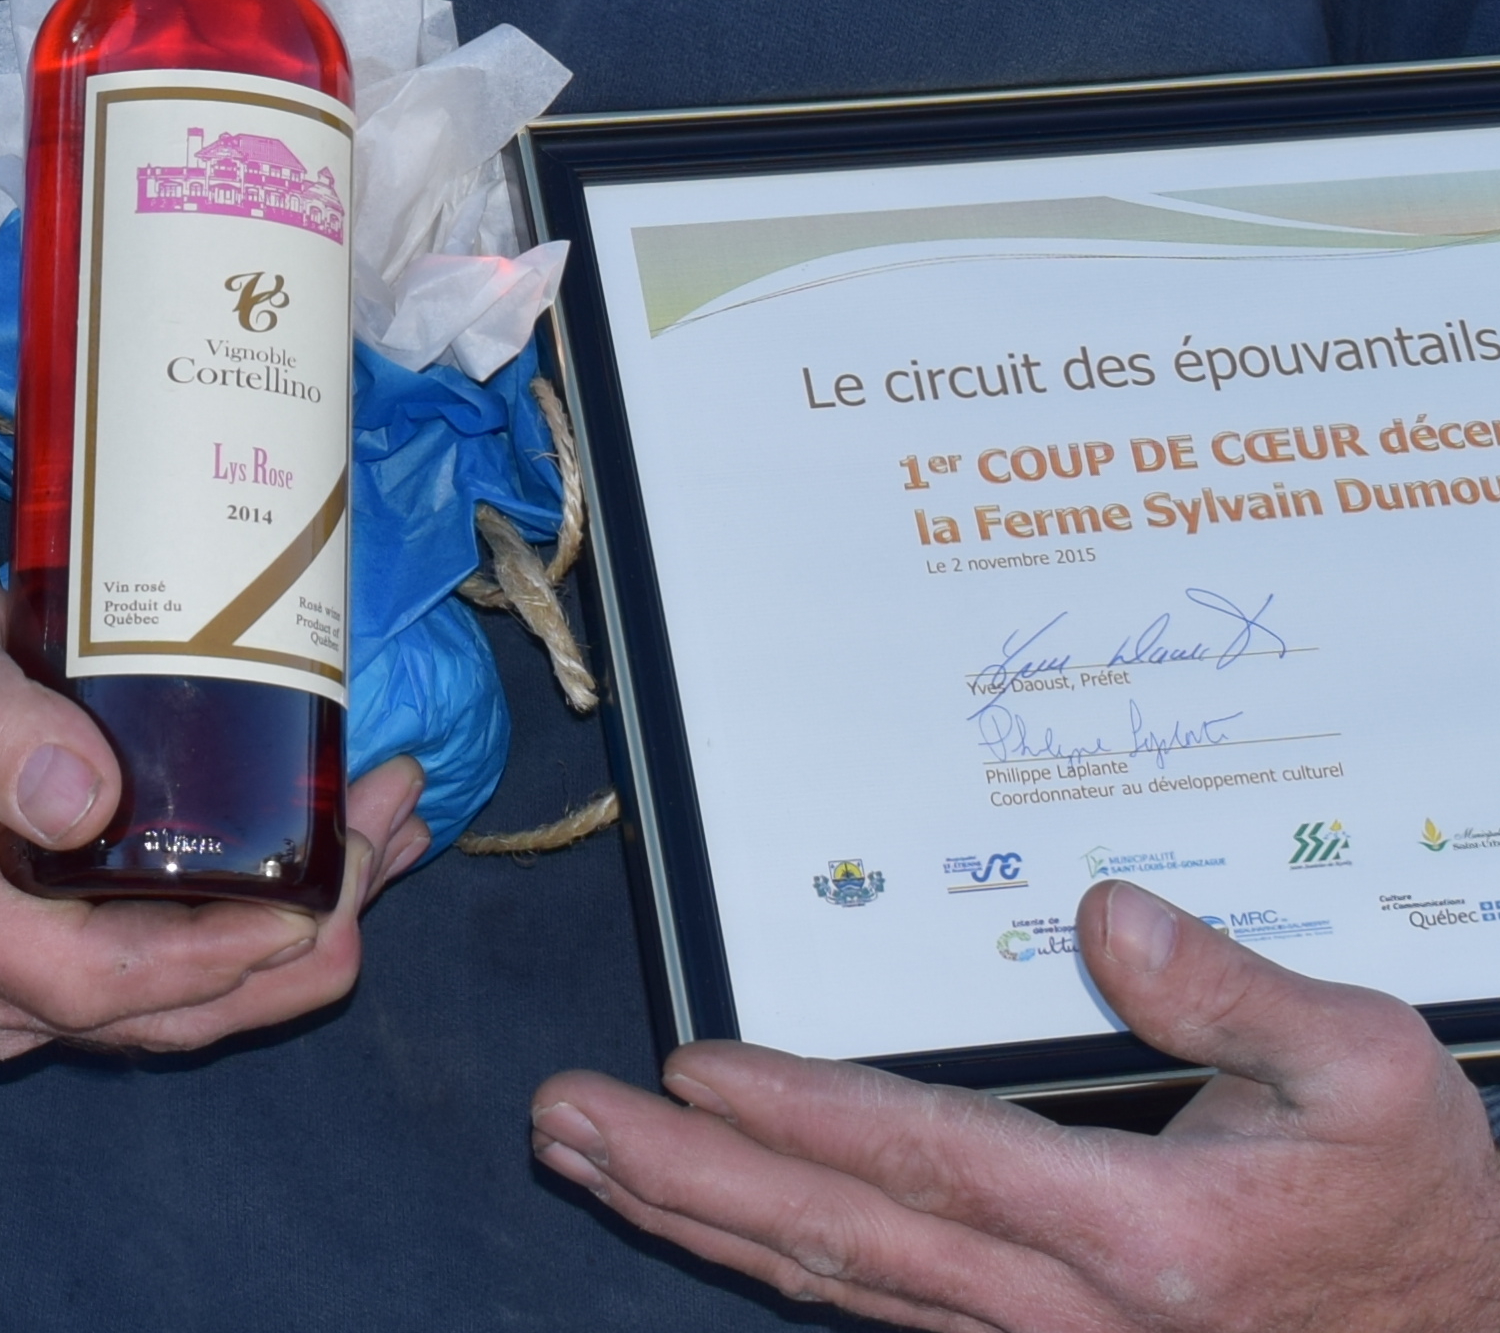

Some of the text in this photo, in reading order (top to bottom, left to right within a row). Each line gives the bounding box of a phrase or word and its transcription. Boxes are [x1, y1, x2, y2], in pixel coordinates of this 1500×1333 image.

[205, 338, 297, 368] Vignoble
[166, 356, 322, 404] Cortellino
[802, 366, 867, 410] Le
[884, 353, 1048, 404] circuit
[1062, 345, 1156, 391] des
[213, 442, 294, 490] Lys Rose
[899, 453, 963, 491] 1er
[977, 440, 1116, 484] COUP
[1130, 434, 1199, 473] DE
[1210, 421, 1370, 467] CŒUR
[226, 504, 273, 525] 2014
[914, 508, 962, 546] la
[973, 502, 1133, 542] Ferme
[1142, 481, 1324, 535] Sylvain
[926, 547, 1097, 575] Le 2 novembre 2015
[104, 580, 166, 593] Vin rosé
[104, 600, 182, 612] Produit du
[299, 596, 322, 613] Rosé
[103, 613, 159, 628] Québec
[296, 613, 331, 634] Product
[967, 670, 1132, 696] Yves Daoust, Préfet
[985, 760, 1129, 786] Philippe Laplante
[990, 762, 1345, 808] Coordonnateur au développement culturel
[1379, 894, 1412, 903] Culture
[1230, 910, 1279, 927] MRC
[1409, 908, 1480, 930] Québec
